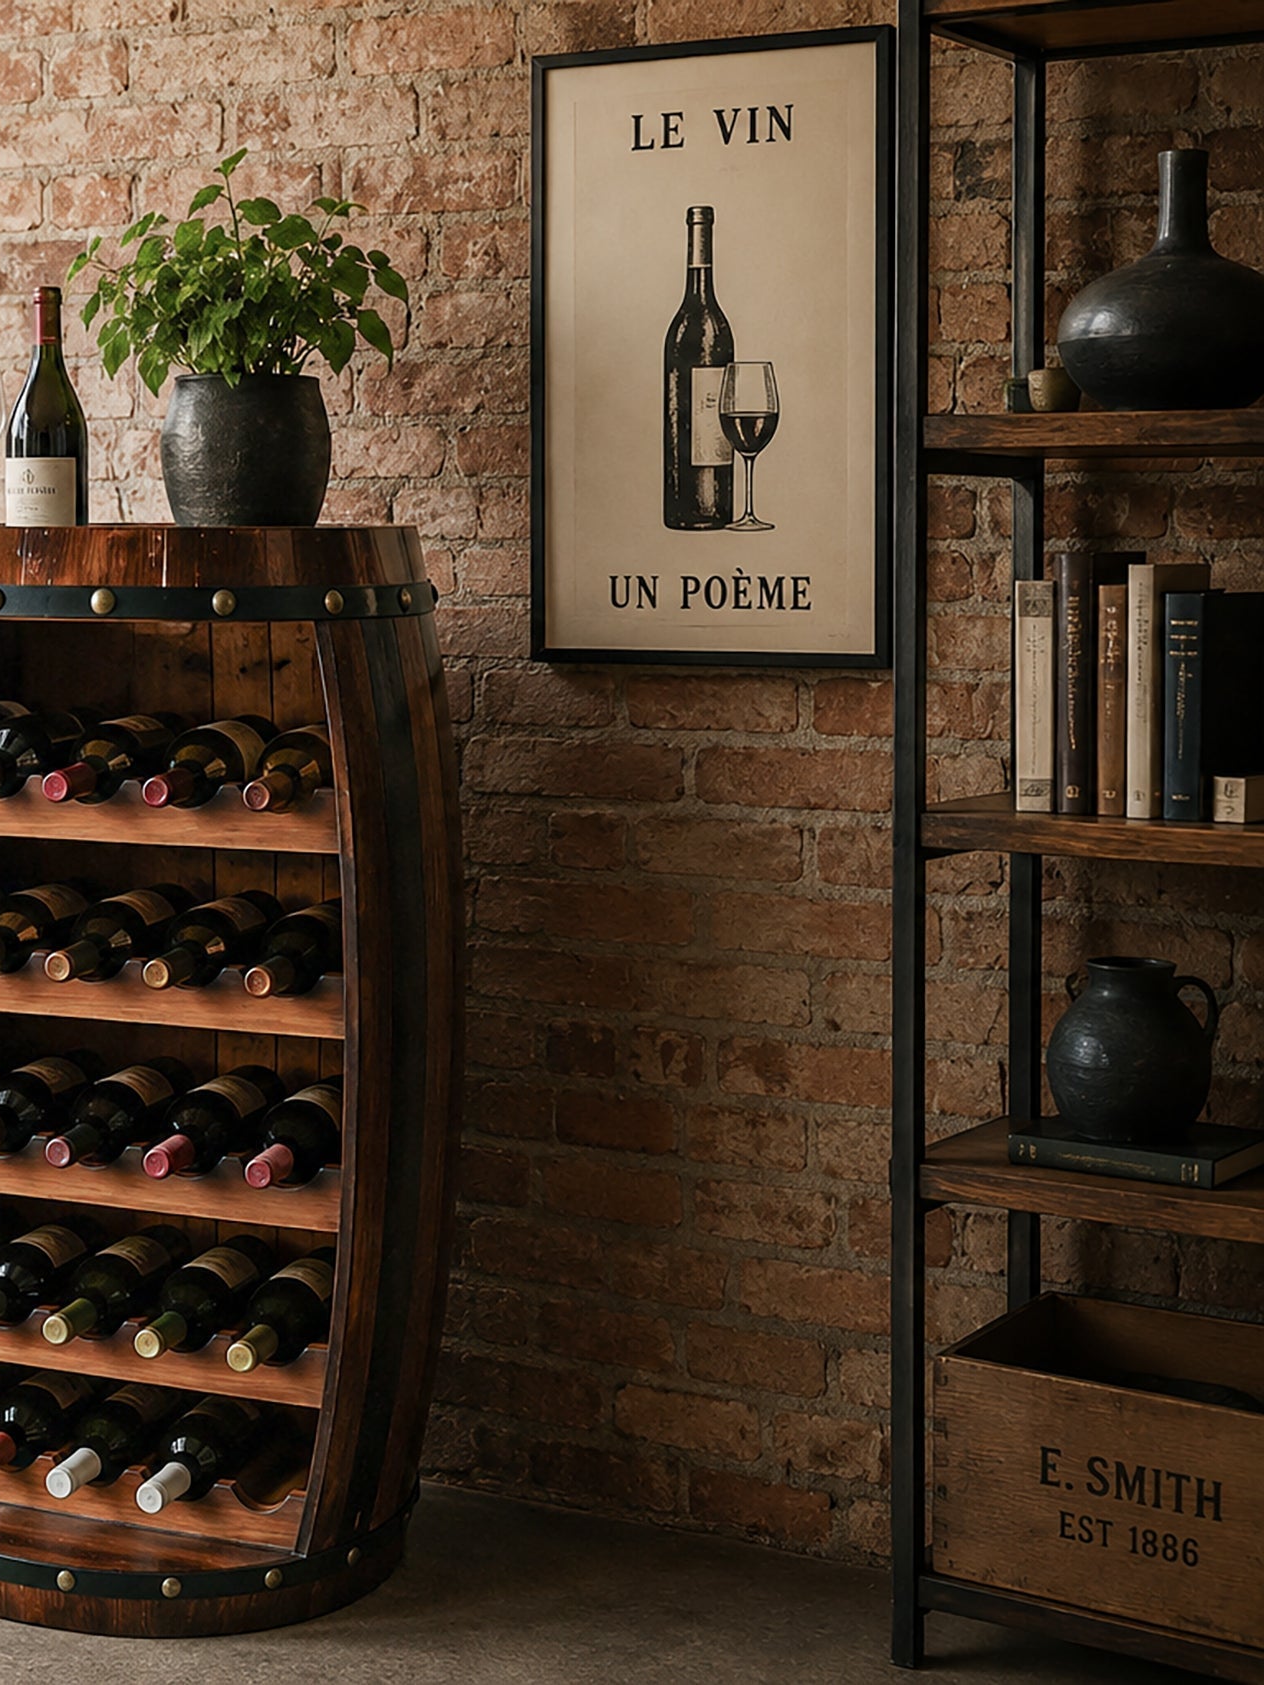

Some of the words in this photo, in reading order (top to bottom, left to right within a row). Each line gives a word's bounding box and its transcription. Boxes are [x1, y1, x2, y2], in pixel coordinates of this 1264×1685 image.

[631, 111, 685, 152] LE
[712, 103, 795, 145] VIN
[609, 575, 659, 610] UN
[679, 566, 813, 611] POÈME
[1039, 1446, 1074, 1491] E.
[1086, 1456, 1223, 1522] SMITH
[1059, 1510, 1114, 1548] EST
[1129, 1526, 1200, 1567] 1886
